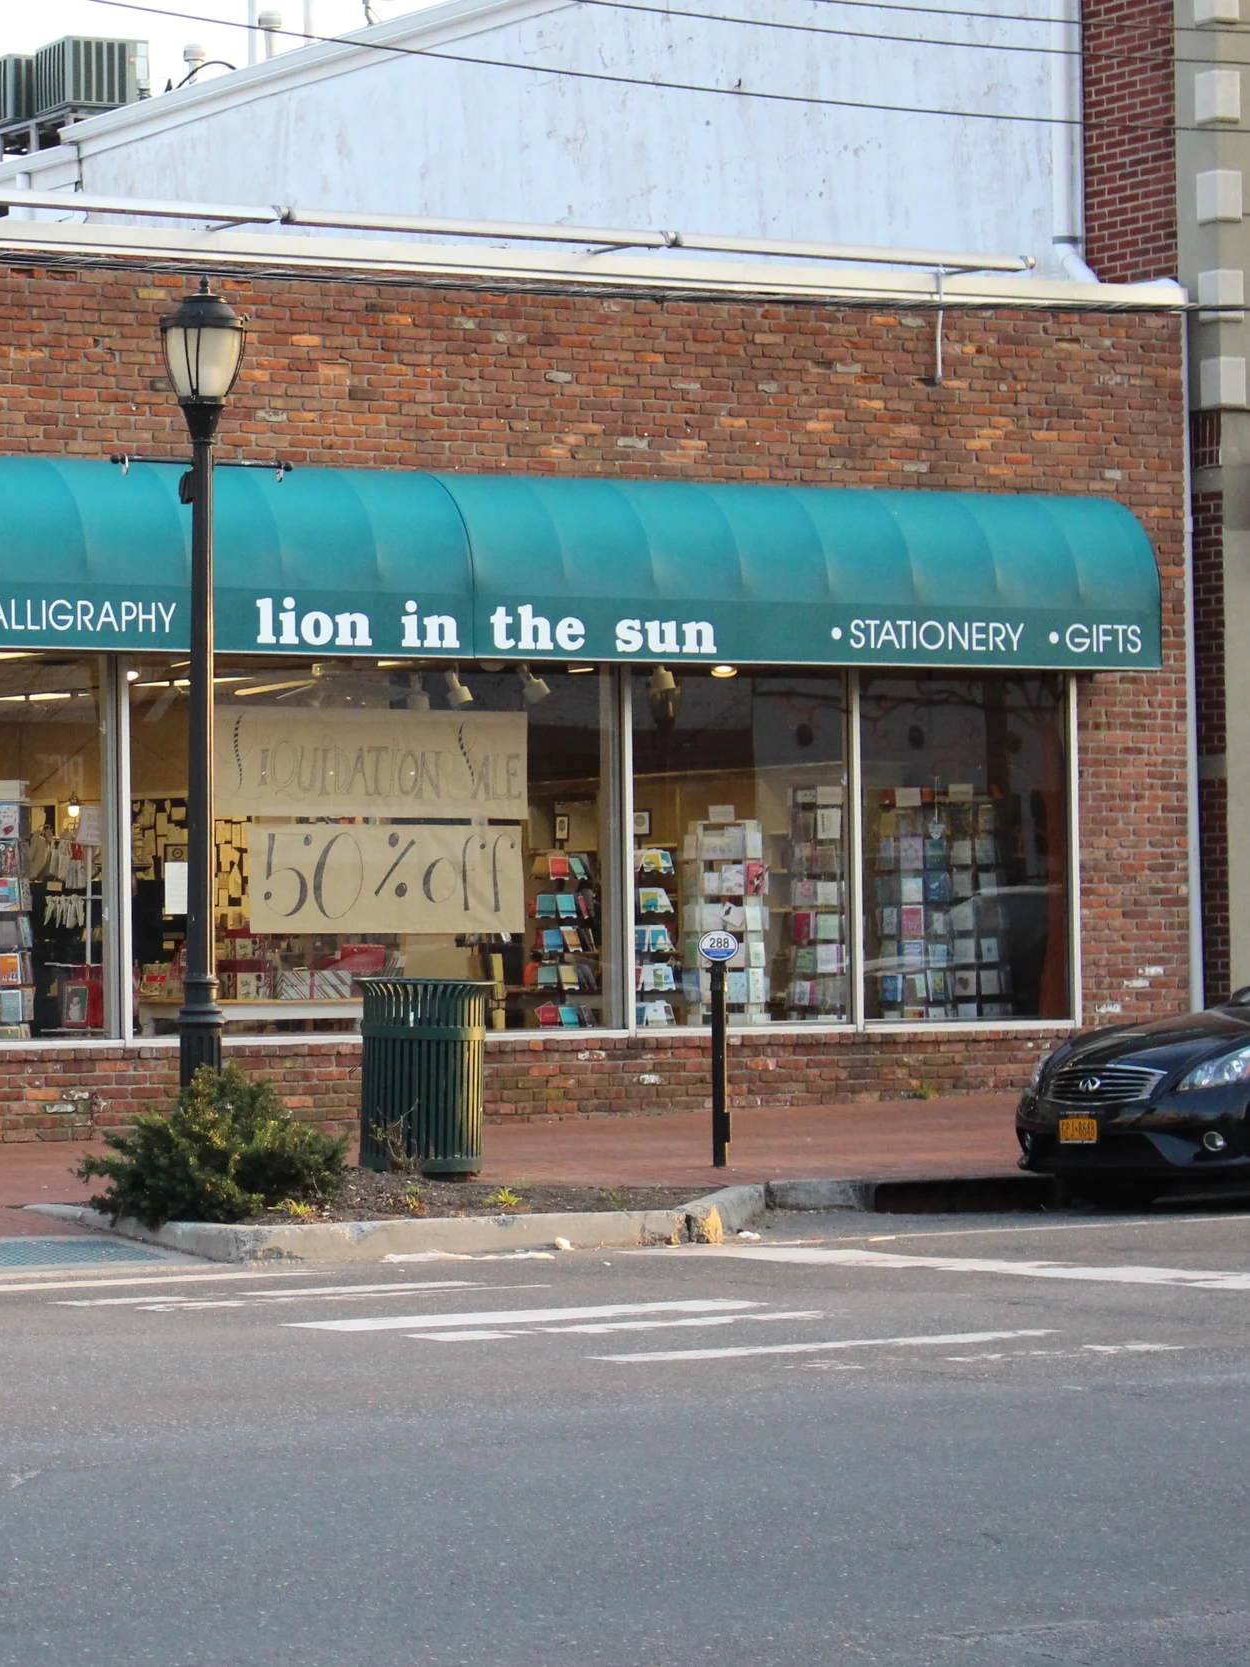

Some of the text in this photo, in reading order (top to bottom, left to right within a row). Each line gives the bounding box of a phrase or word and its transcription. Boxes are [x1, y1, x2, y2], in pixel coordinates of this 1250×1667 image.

[256, 597, 718, 654] lion in the sun
[849, 618, 1025, 652] STATIONERY
[1065, 622, 1142, 654] GIFTS
[450, 720, 522, 800] SALE
[263, 832, 417, 920] 50%
[709, 937, 730, 949] 288
